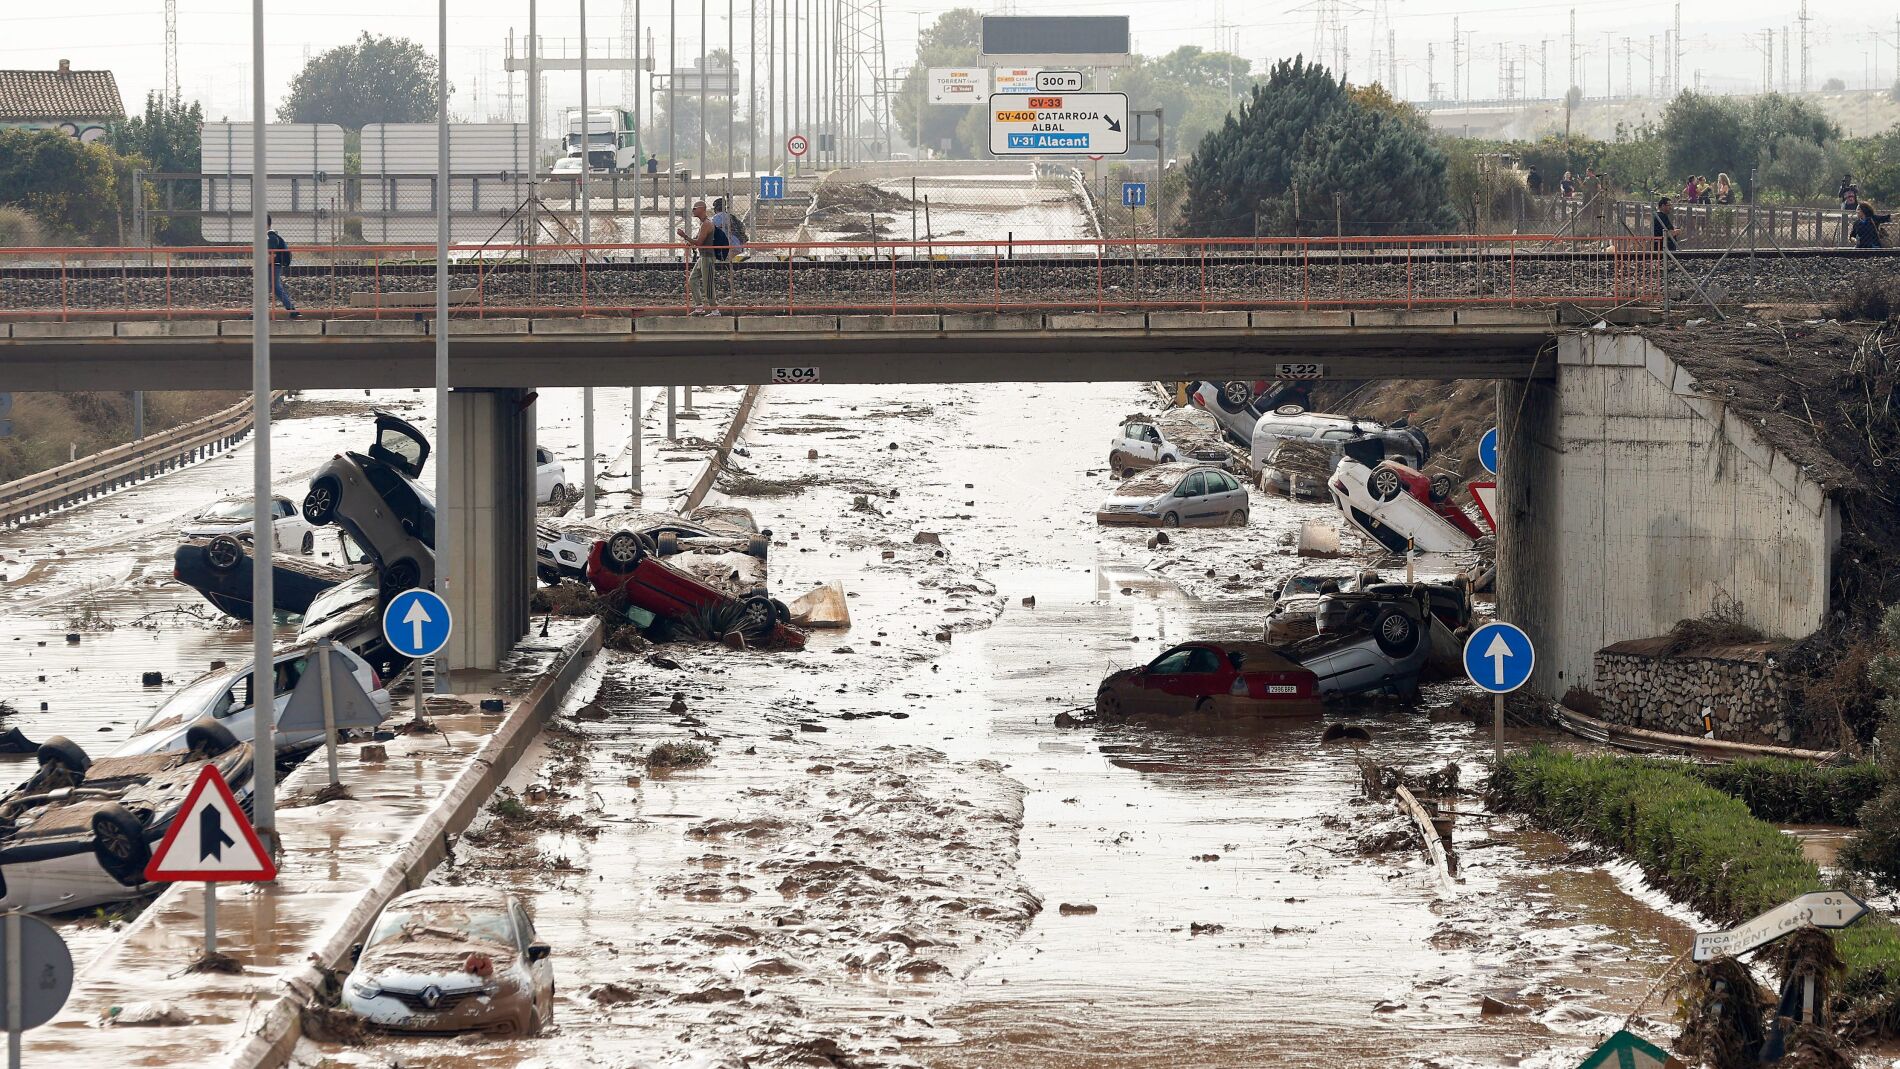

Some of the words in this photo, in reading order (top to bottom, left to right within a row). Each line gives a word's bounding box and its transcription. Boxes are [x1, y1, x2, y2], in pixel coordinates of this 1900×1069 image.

[1042, 77, 1064, 86] 300
[1067, 78, 1076, 86] m
[1030, 98, 1061, 107] CV-33
[997, 112, 1036, 121] CV-400
[1037, 112, 1099, 120] CATARROJA
[1031, 123, 1065, 132] ALBAL
[791, 142, 805, 150] 100
[1012, 136, 1034, 146] V-31
[1038, 136, 1088, 147] Alacant
[776, 368, 815, 379] 5.04
[1282, 364, 1317, 374] 5.22
[1777, 908, 1814, 930] (est)
[1836, 909, 1842, 920] 1
[1702, 927, 1752, 945] PICANYA
